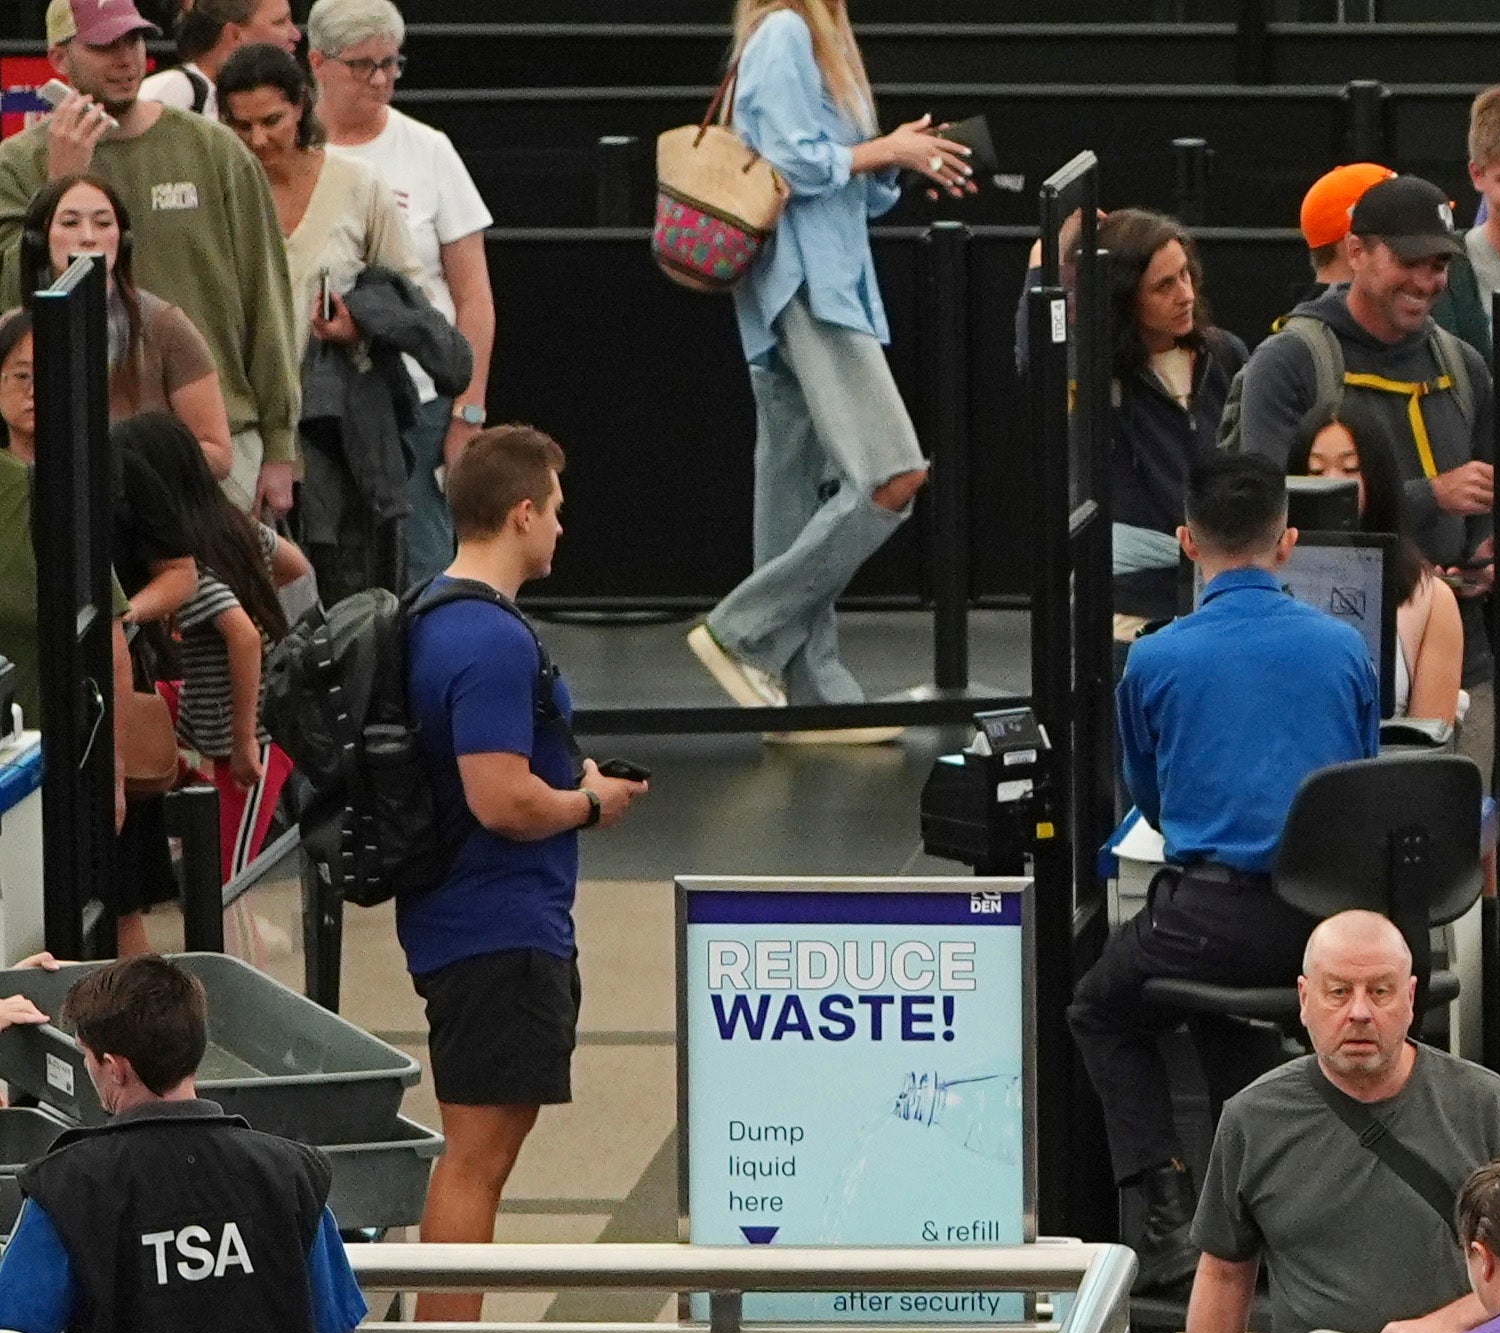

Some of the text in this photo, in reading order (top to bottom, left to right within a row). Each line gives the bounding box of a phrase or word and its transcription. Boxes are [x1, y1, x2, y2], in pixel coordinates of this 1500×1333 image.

[970, 899, 1002, 914] DEN
[708, 941, 977, 991] REDUCE
[712, 994, 956, 1041] WASTE!
[729, 1120, 804, 1146] Dump
[729, 1155, 796, 1181] liquid
[729, 1190, 783, 1212] here
[922, 1219, 999, 1242] & refill
[141, 1222, 255, 1285] TSA
[834, 1291, 1000, 1316] after security
